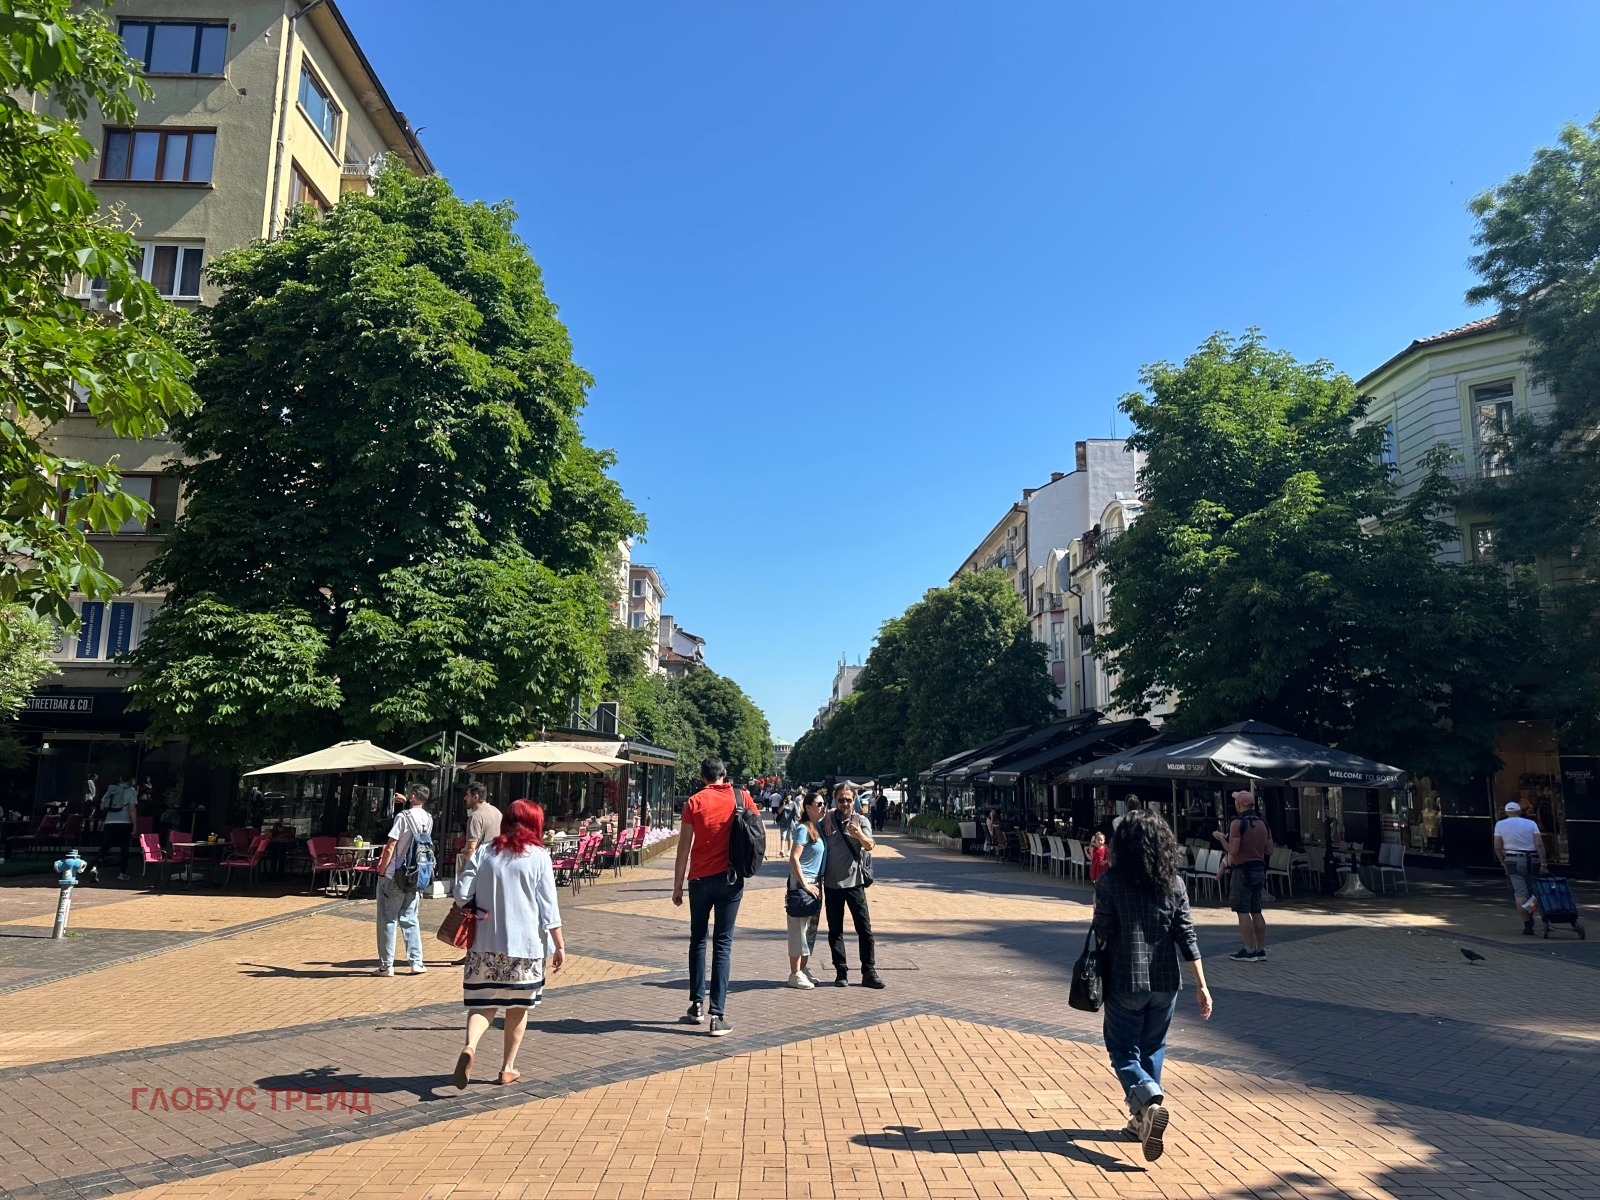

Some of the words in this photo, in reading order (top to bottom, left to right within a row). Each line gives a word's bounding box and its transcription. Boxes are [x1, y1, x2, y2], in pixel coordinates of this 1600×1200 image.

[26, 698, 69, 710] STREETBAR
[69, 699, 76, 710] &
[1328, 769, 1363, 780] WELCOME
[1365, 773, 1374, 781] TO
